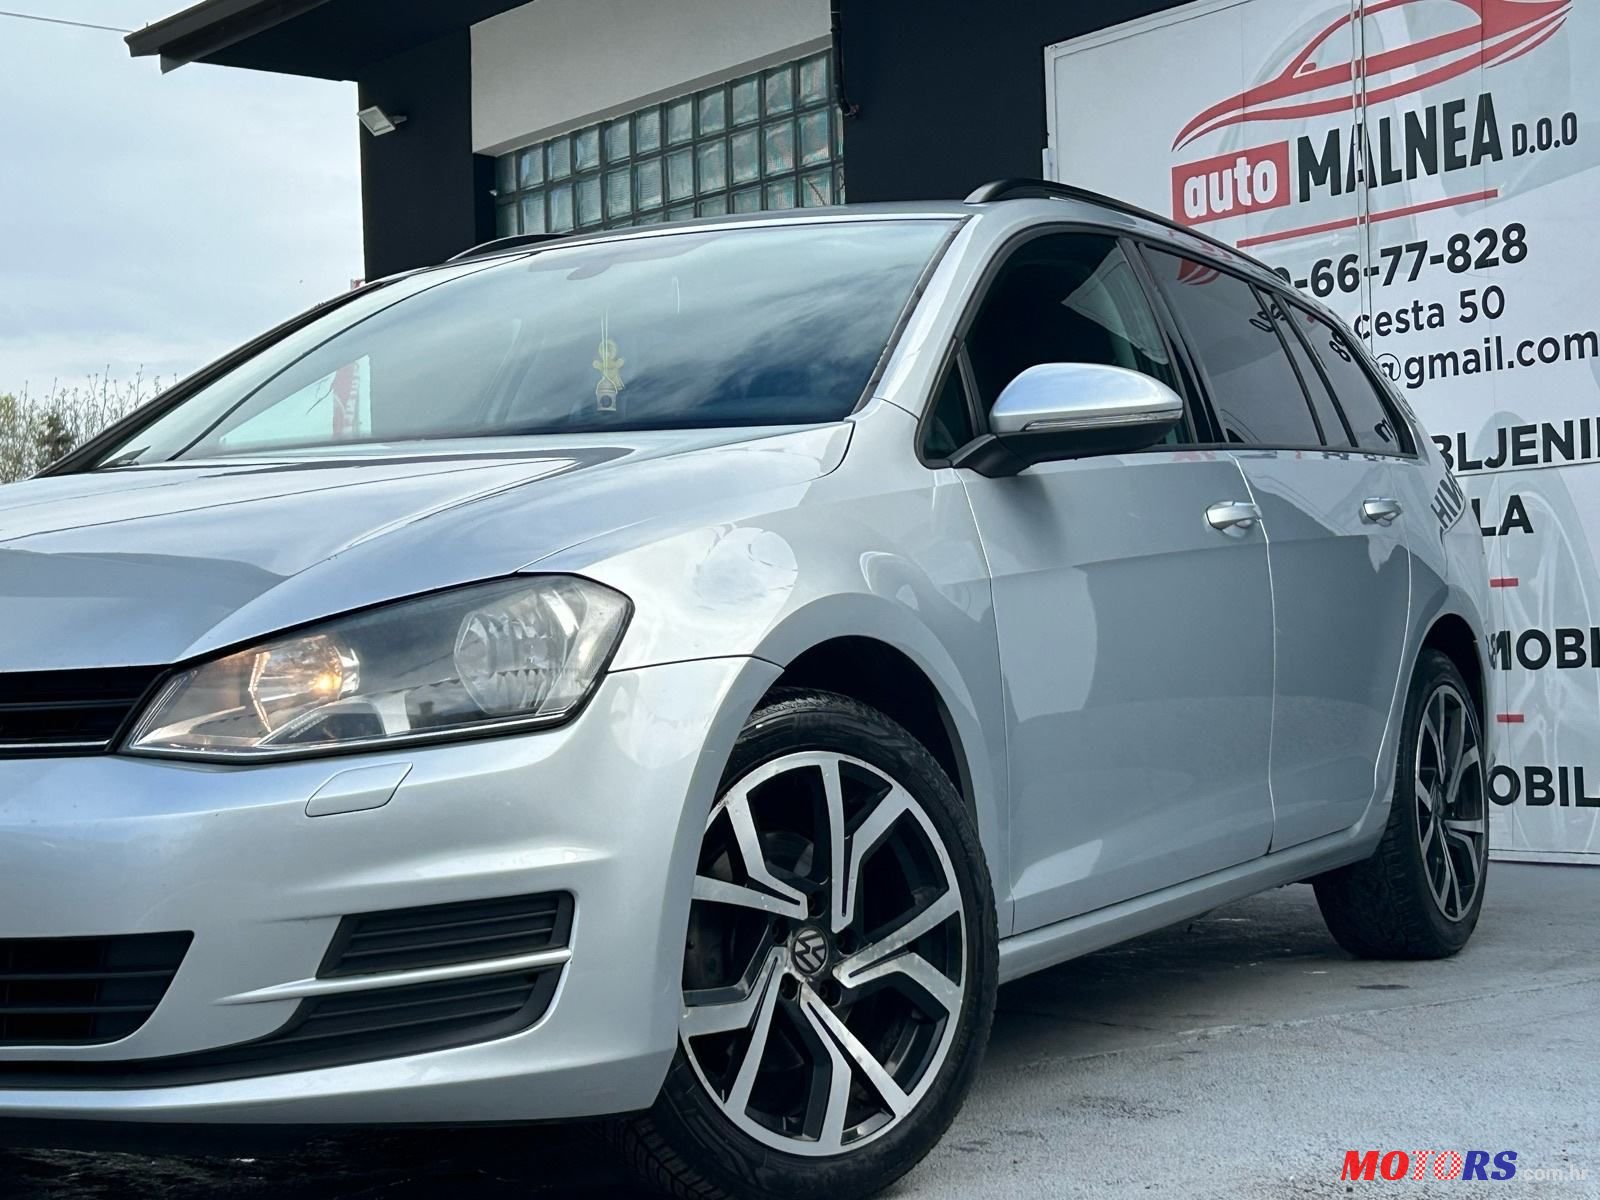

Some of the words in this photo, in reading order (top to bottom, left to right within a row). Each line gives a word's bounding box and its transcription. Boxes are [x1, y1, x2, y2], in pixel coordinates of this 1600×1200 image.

[1183, 156, 1278, 220] auto
[1297, 92, 1503, 203] MALNEA
[1353, 299, 1445, 340] cesta
[1458, 285, 1505, 323] 50
[1430, 416, 1600, 472] BLJENI
